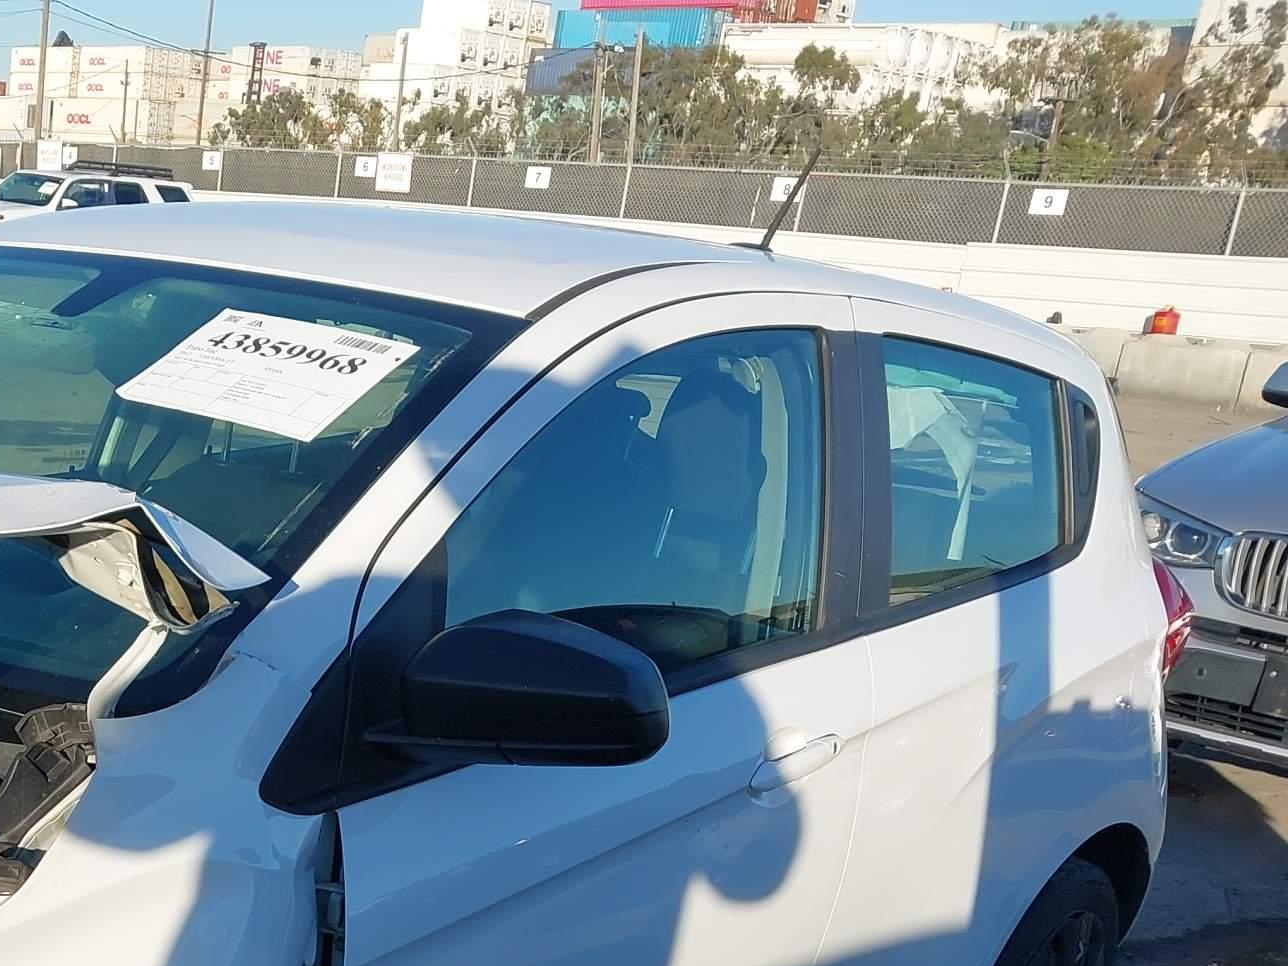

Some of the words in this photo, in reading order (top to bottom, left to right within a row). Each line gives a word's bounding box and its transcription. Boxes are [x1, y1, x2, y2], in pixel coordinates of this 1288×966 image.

[20, 58, 36, 66] OOCL
[89, 57, 106, 66] OOCL
[18, 83, 34, 91] OOCL
[87, 83, 104, 92] OOCL
[67, 113, 91, 124] OOCL
[209, 155, 215, 165] 5
[363, 161, 369, 172] 6
[535, 172, 542, 183] 7
[783, 183, 791, 195] 8
[1043, 195, 1053, 209] 9
[208, 331, 368, 375] 43859968
